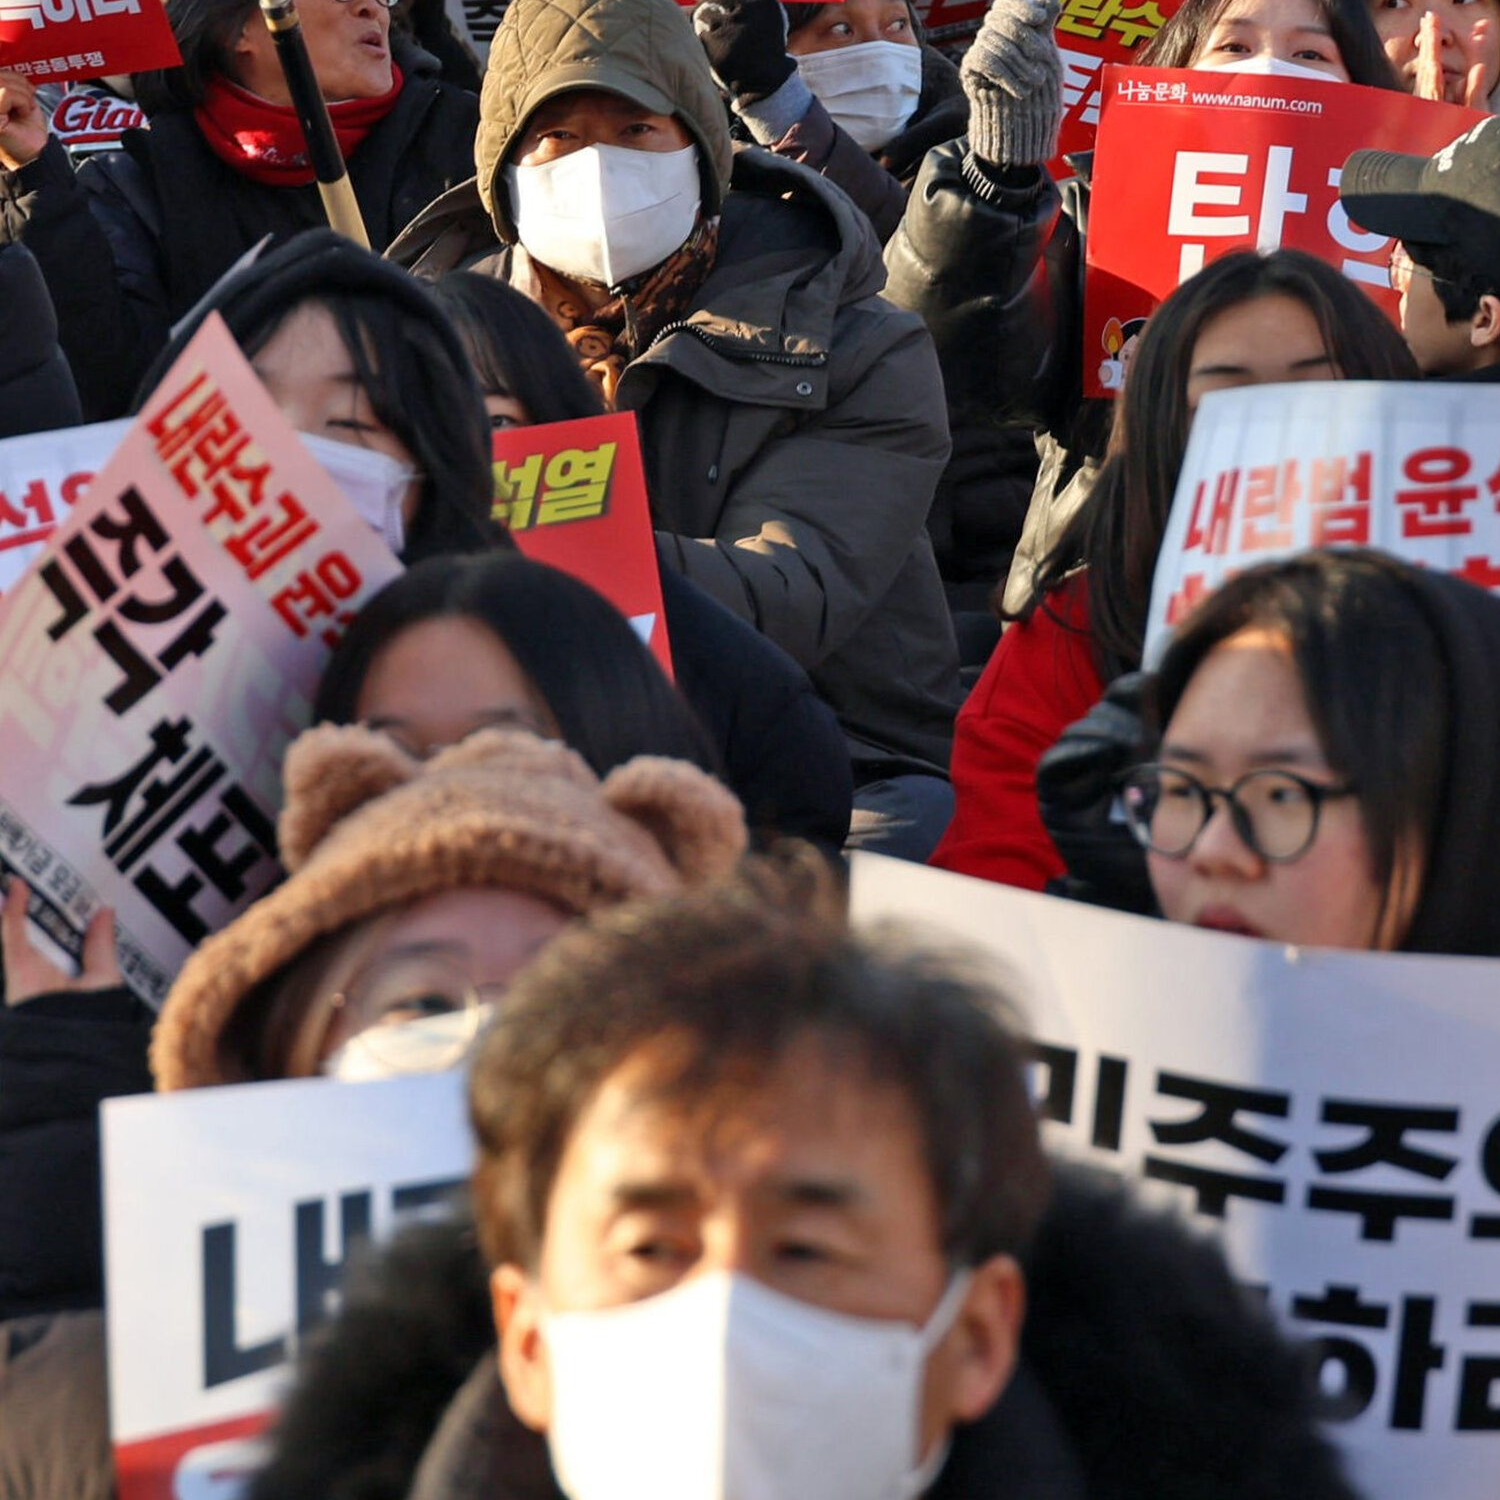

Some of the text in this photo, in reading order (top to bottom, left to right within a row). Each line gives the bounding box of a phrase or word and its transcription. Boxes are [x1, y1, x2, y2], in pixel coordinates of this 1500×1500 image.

[1117, 81, 1322, 115] 나눔문화 www.nanum.com
[146, 371, 320, 577] 내란수괴
[1182, 452, 1373, 556] 내란범
[38, 484, 228, 716] 즉각
[63, 716, 285, 946] 체포
